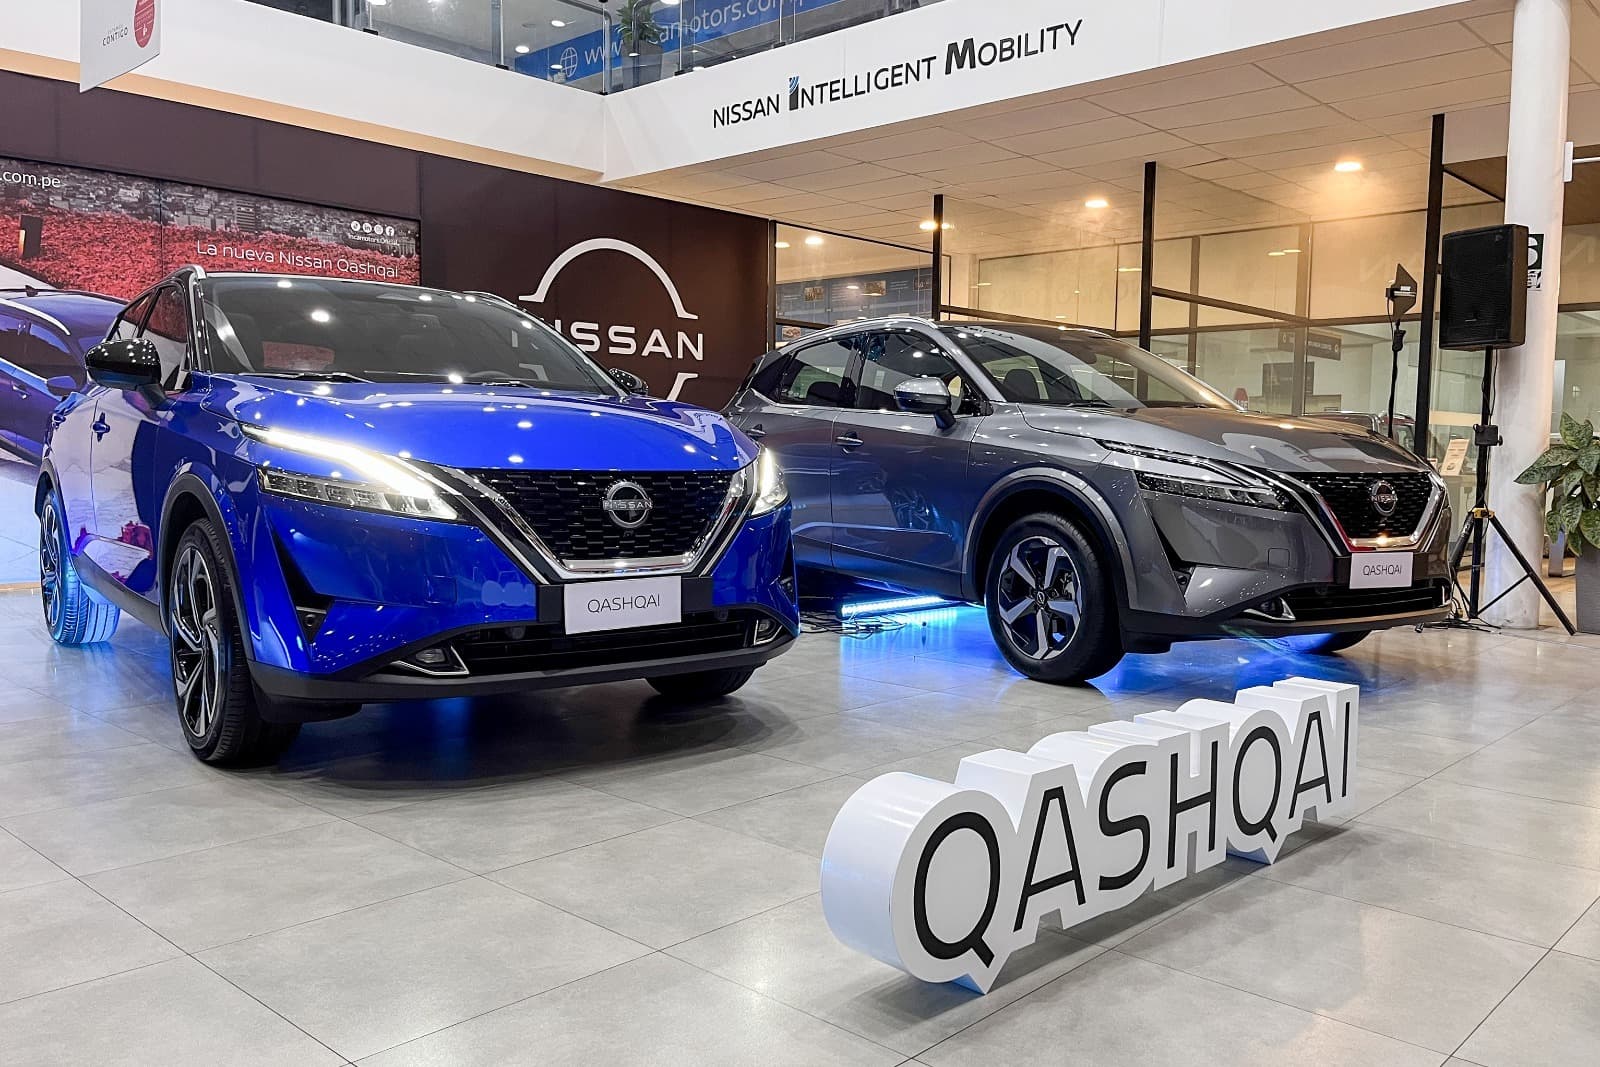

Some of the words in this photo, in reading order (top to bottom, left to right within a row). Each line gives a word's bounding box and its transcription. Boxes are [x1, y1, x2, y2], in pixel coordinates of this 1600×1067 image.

[713, 94, 779, 128] NISSAN
[788, 56, 937, 111] INTELLIGENT
[945, 19, 1083, 75] MOBILITY
[197, 240, 217, 256] La
[223, 245, 274, 263] nueva
[279, 251, 332, 270] Nissan
[337, 258, 399, 279] Qashqai
[540, 317, 704, 361] SSAN
[603, 500, 653, 510] NISSAN
[1362, 564, 1402, 577] QASHQAI
[587, 594, 660, 614] QASHQAI
[913, 702, 1351, 968] QASHQAI
